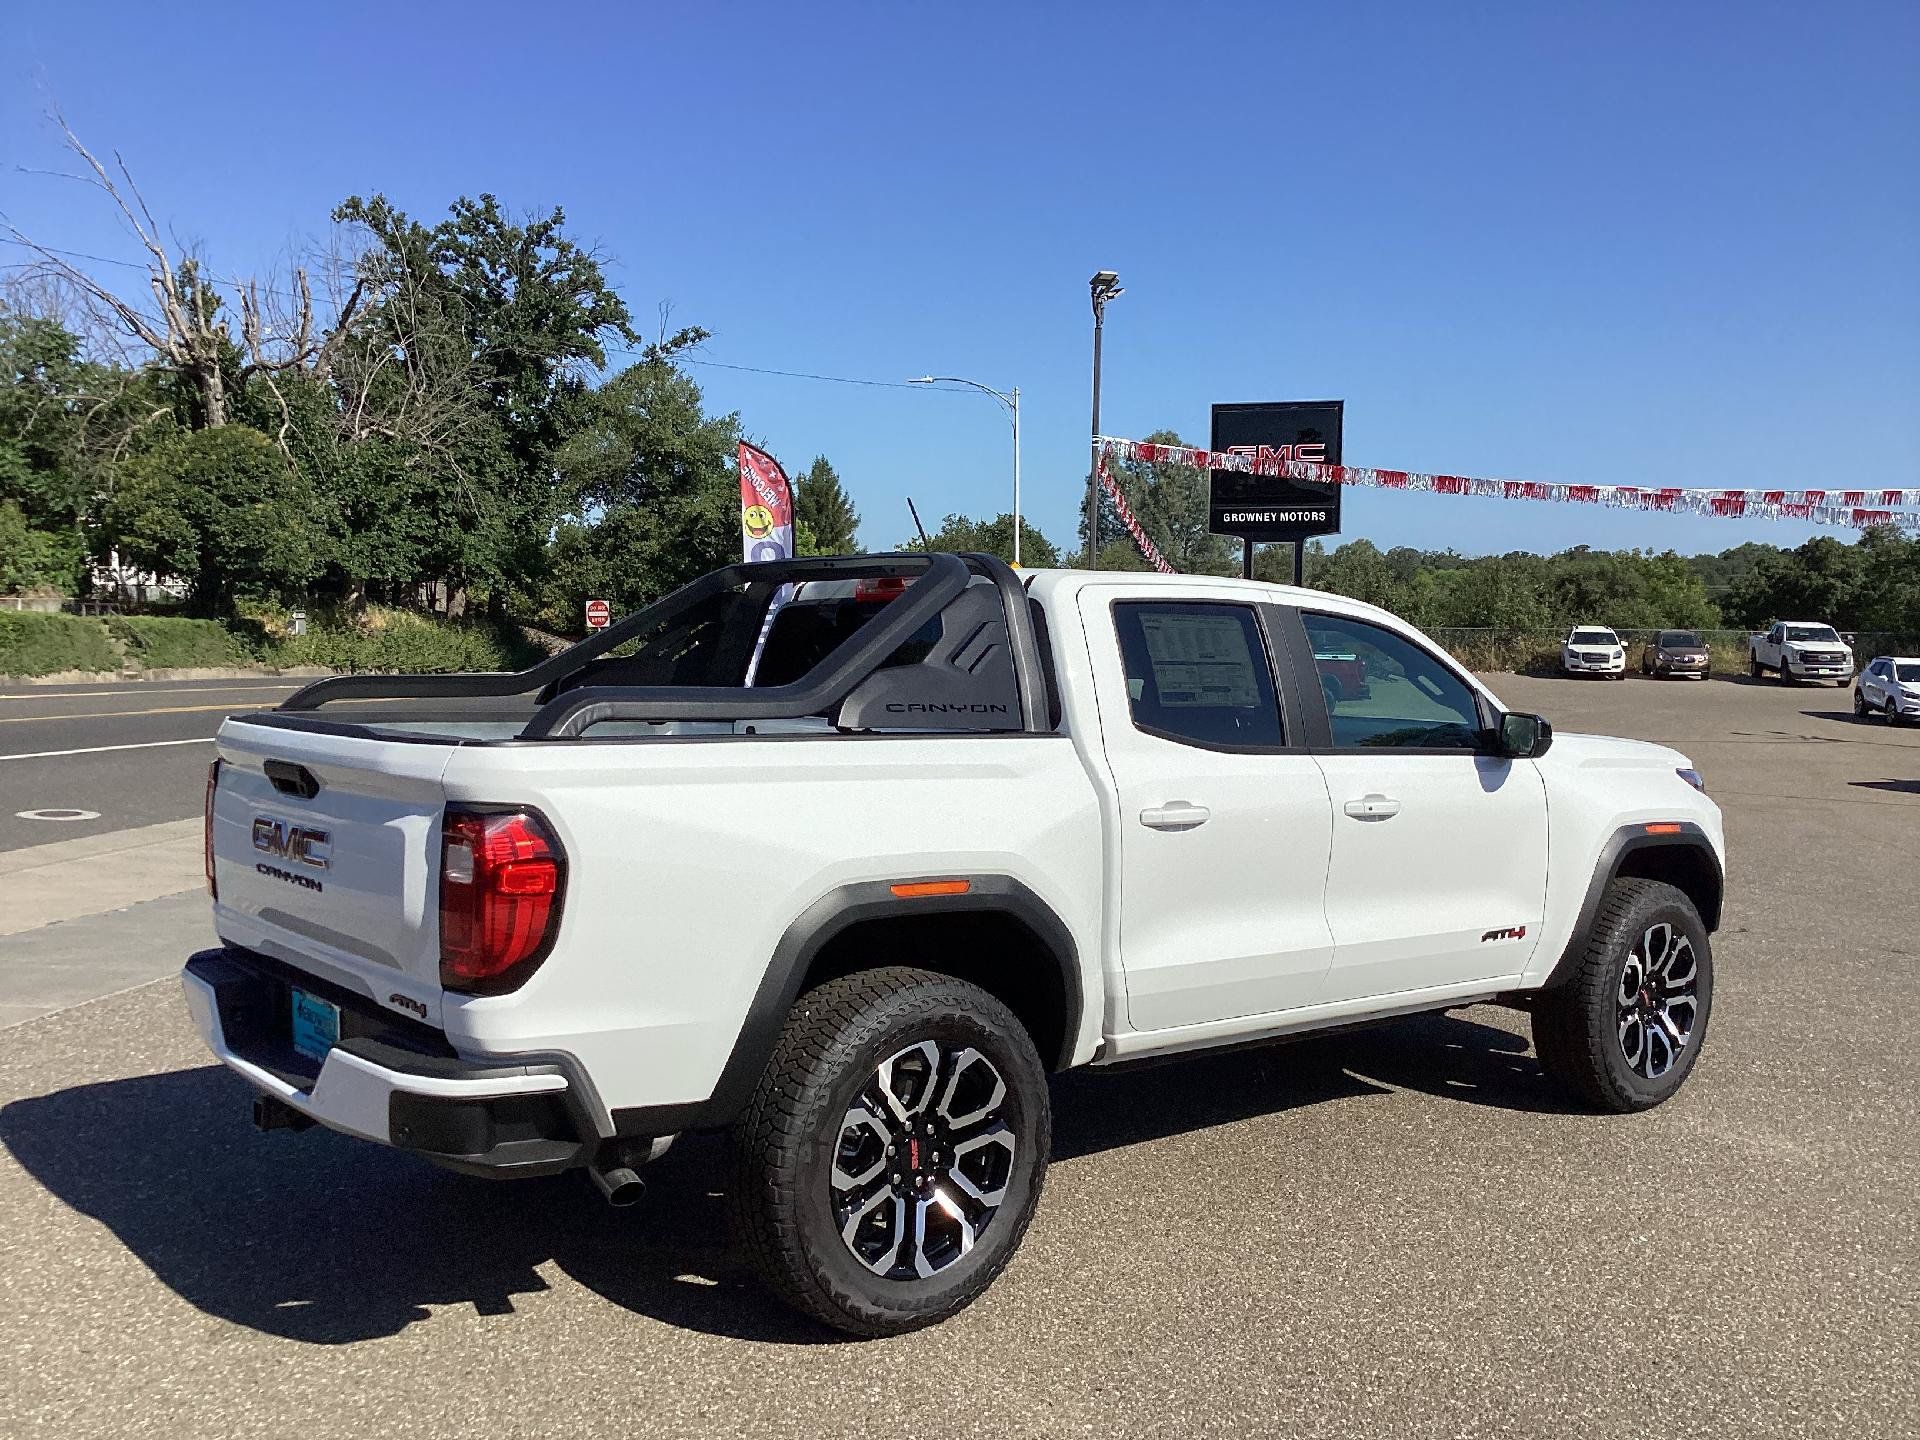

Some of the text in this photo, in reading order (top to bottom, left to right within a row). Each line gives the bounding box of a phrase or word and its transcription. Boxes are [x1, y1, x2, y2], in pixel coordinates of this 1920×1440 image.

[1223, 511, 1326, 522] GROWNEY MOTORS
[886, 703, 1008, 713] CANYON
[252, 816, 332, 870] GMC
[256, 863, 323, 893] CANYON
[1481, 926, 1526, 942] AT4
